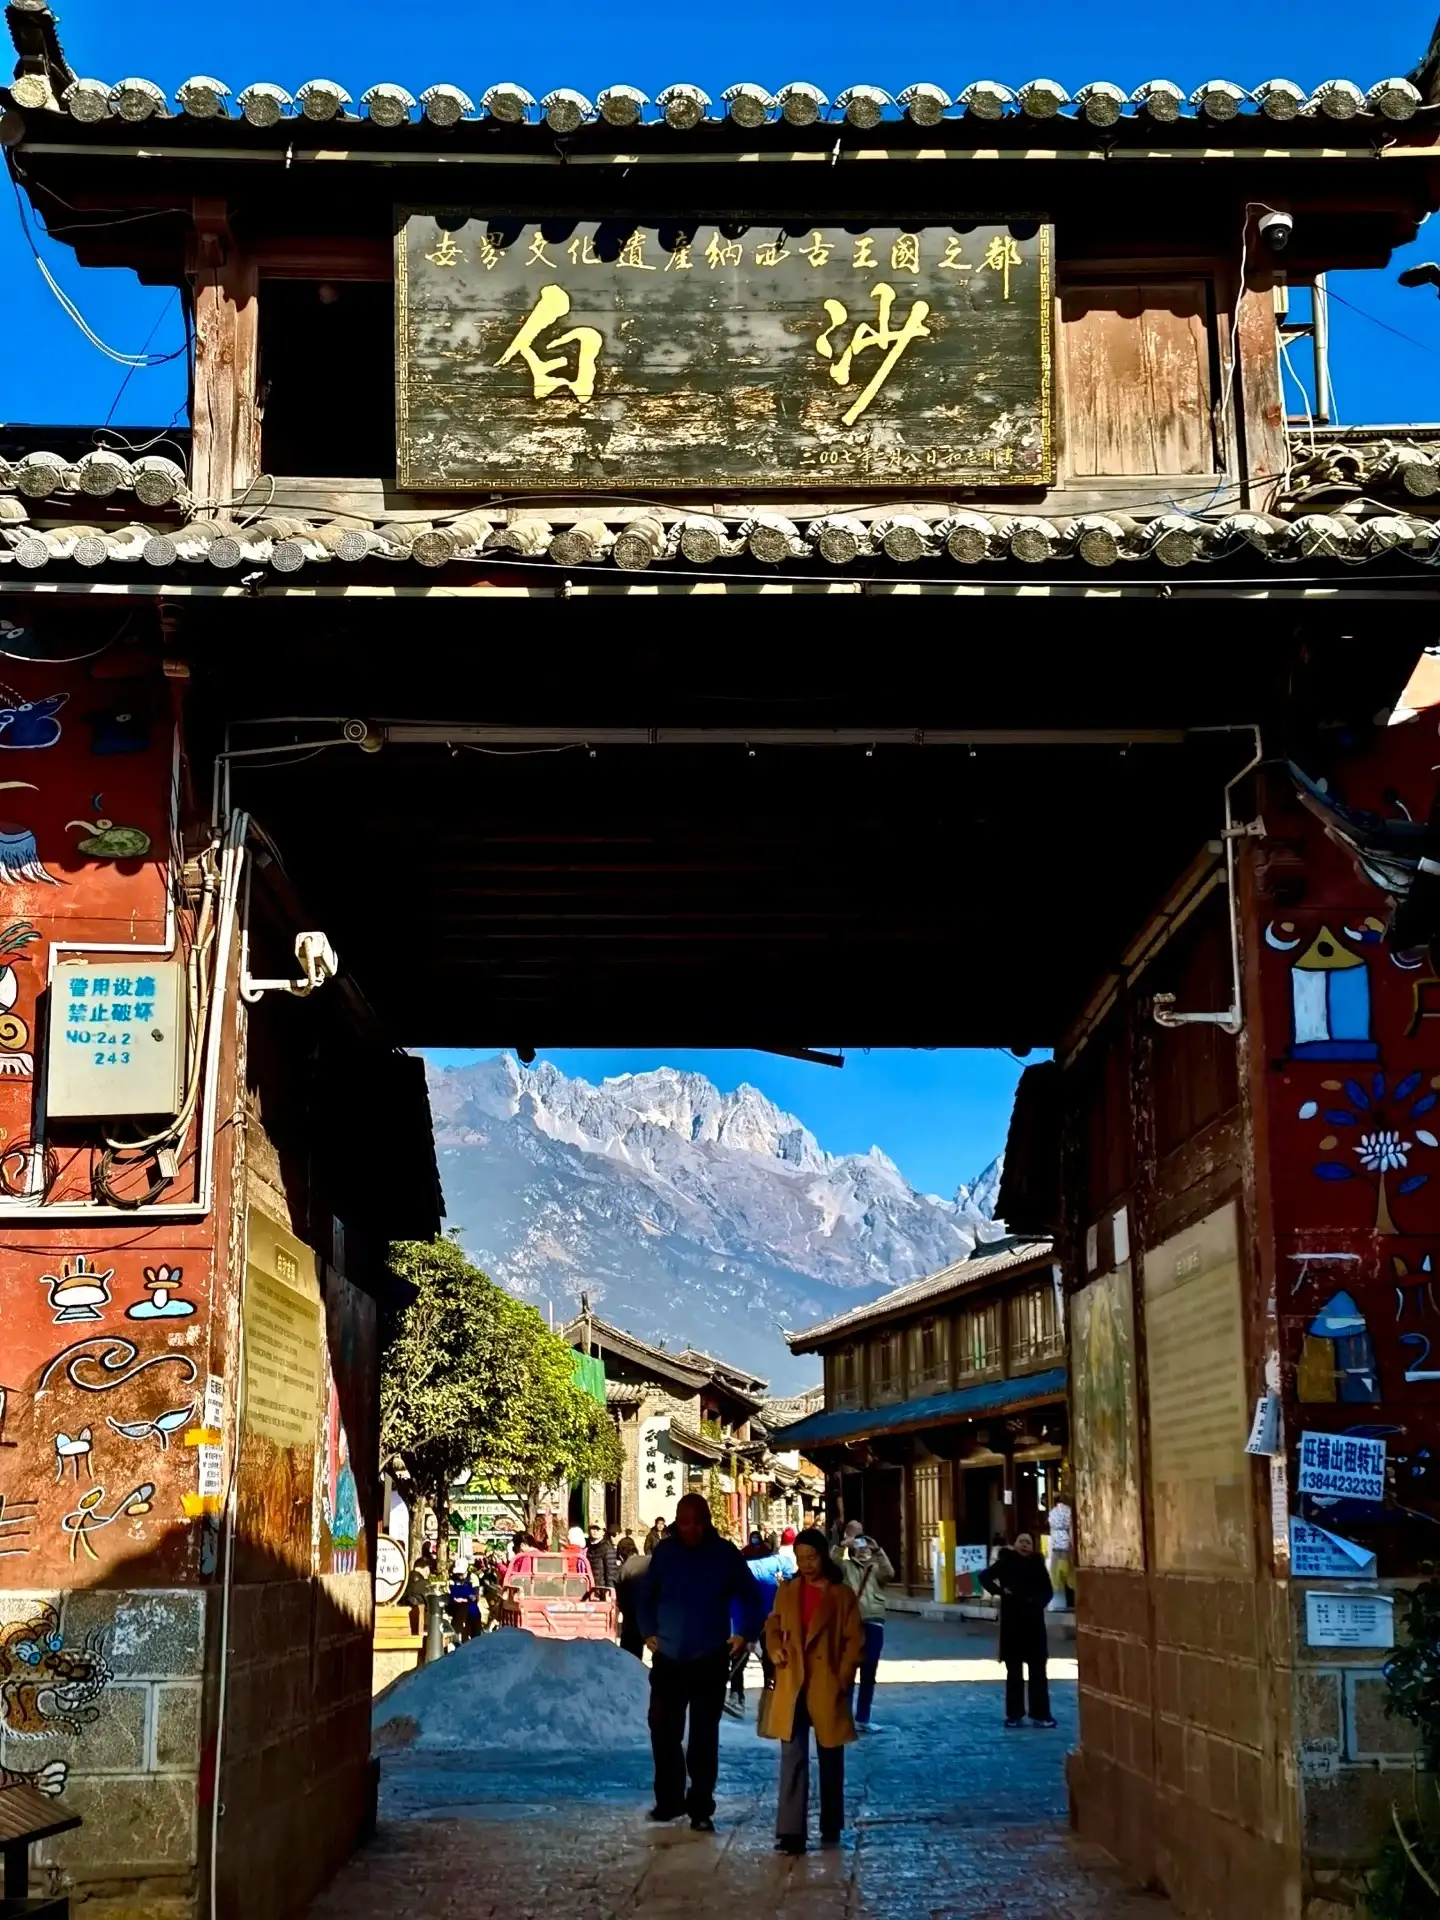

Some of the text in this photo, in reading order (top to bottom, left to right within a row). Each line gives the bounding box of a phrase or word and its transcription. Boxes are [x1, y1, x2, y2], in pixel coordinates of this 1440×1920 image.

[494, 282, 930, 426] 白沙
[67, 1002, 154, 1022] 禁止破坏
[94, 1051, 130, 1065] 243
[1303, 1436, 1383, 1476] 旺铺出租转让
[1302, 1471, 1382, 1497] 13844232333
